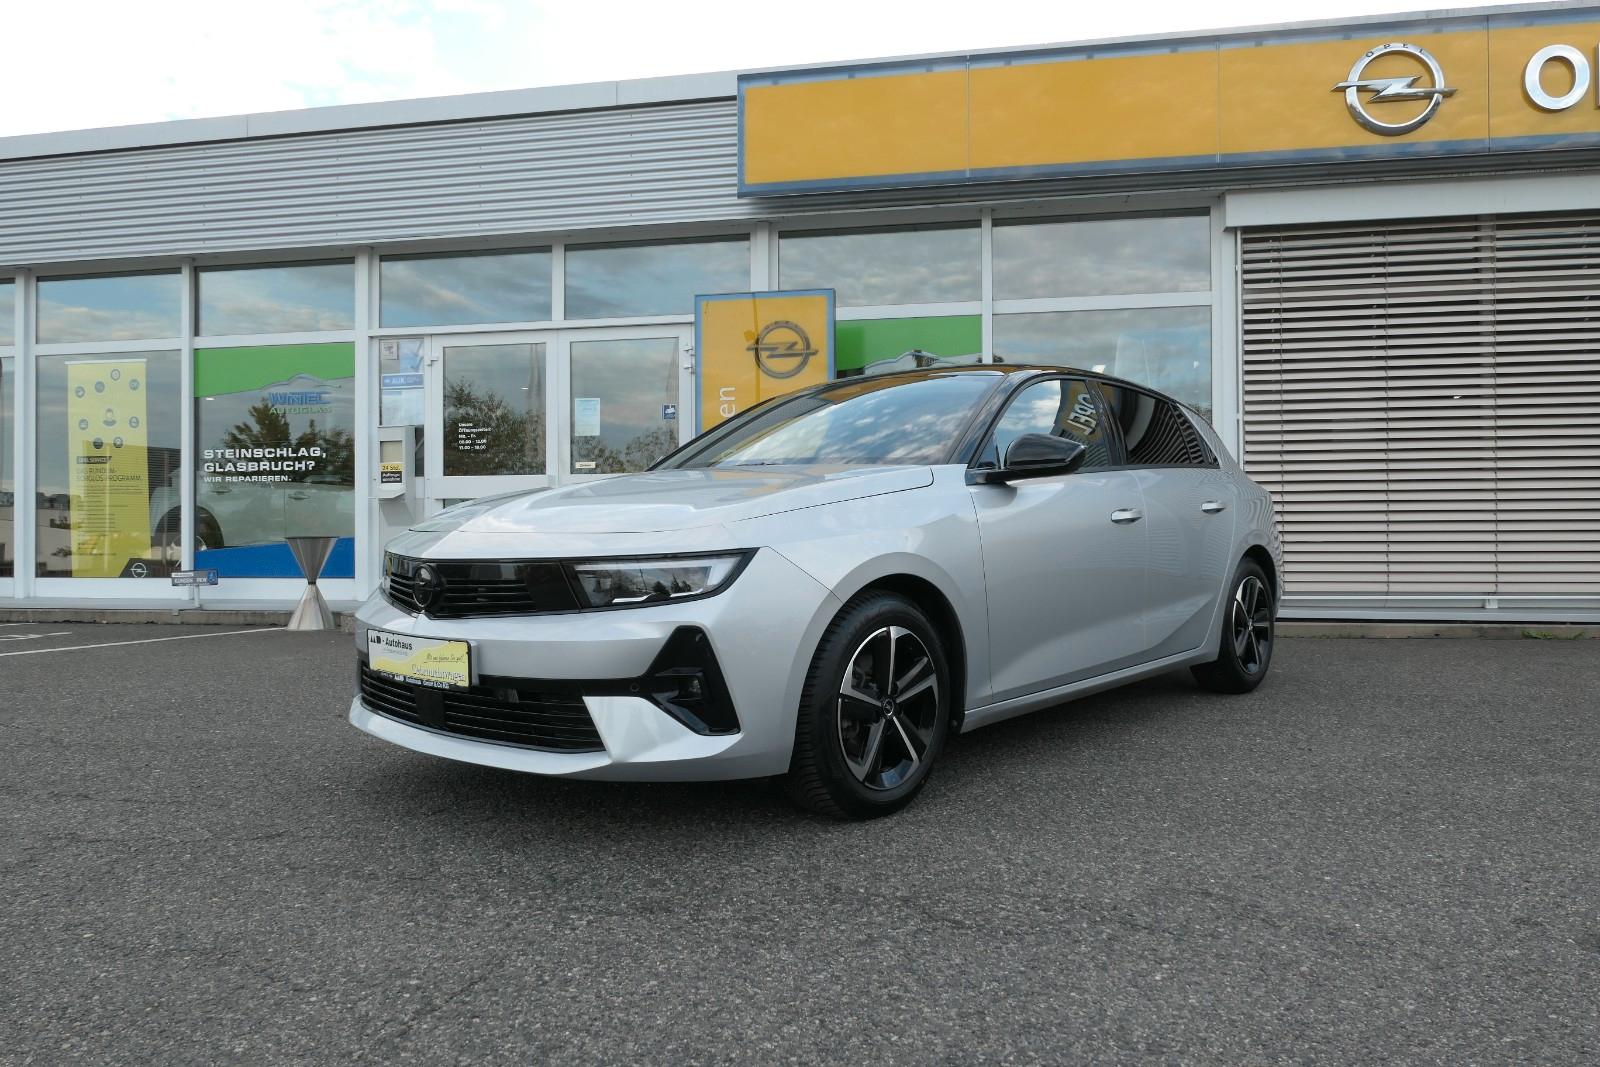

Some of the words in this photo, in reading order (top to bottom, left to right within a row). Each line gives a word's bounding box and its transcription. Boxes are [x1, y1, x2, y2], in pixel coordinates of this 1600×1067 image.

[1365, 43, 1426, 58] OPEL
[1525, 44, 1600, 110] O
[203, 446, 327, 460] STEINSCHLAG,
[203, 460, 315, 473] GLASBRUCH?
[225, 475, 292, 483] REPARIEREN.
[385, 636, 413, 651] Autohaus
